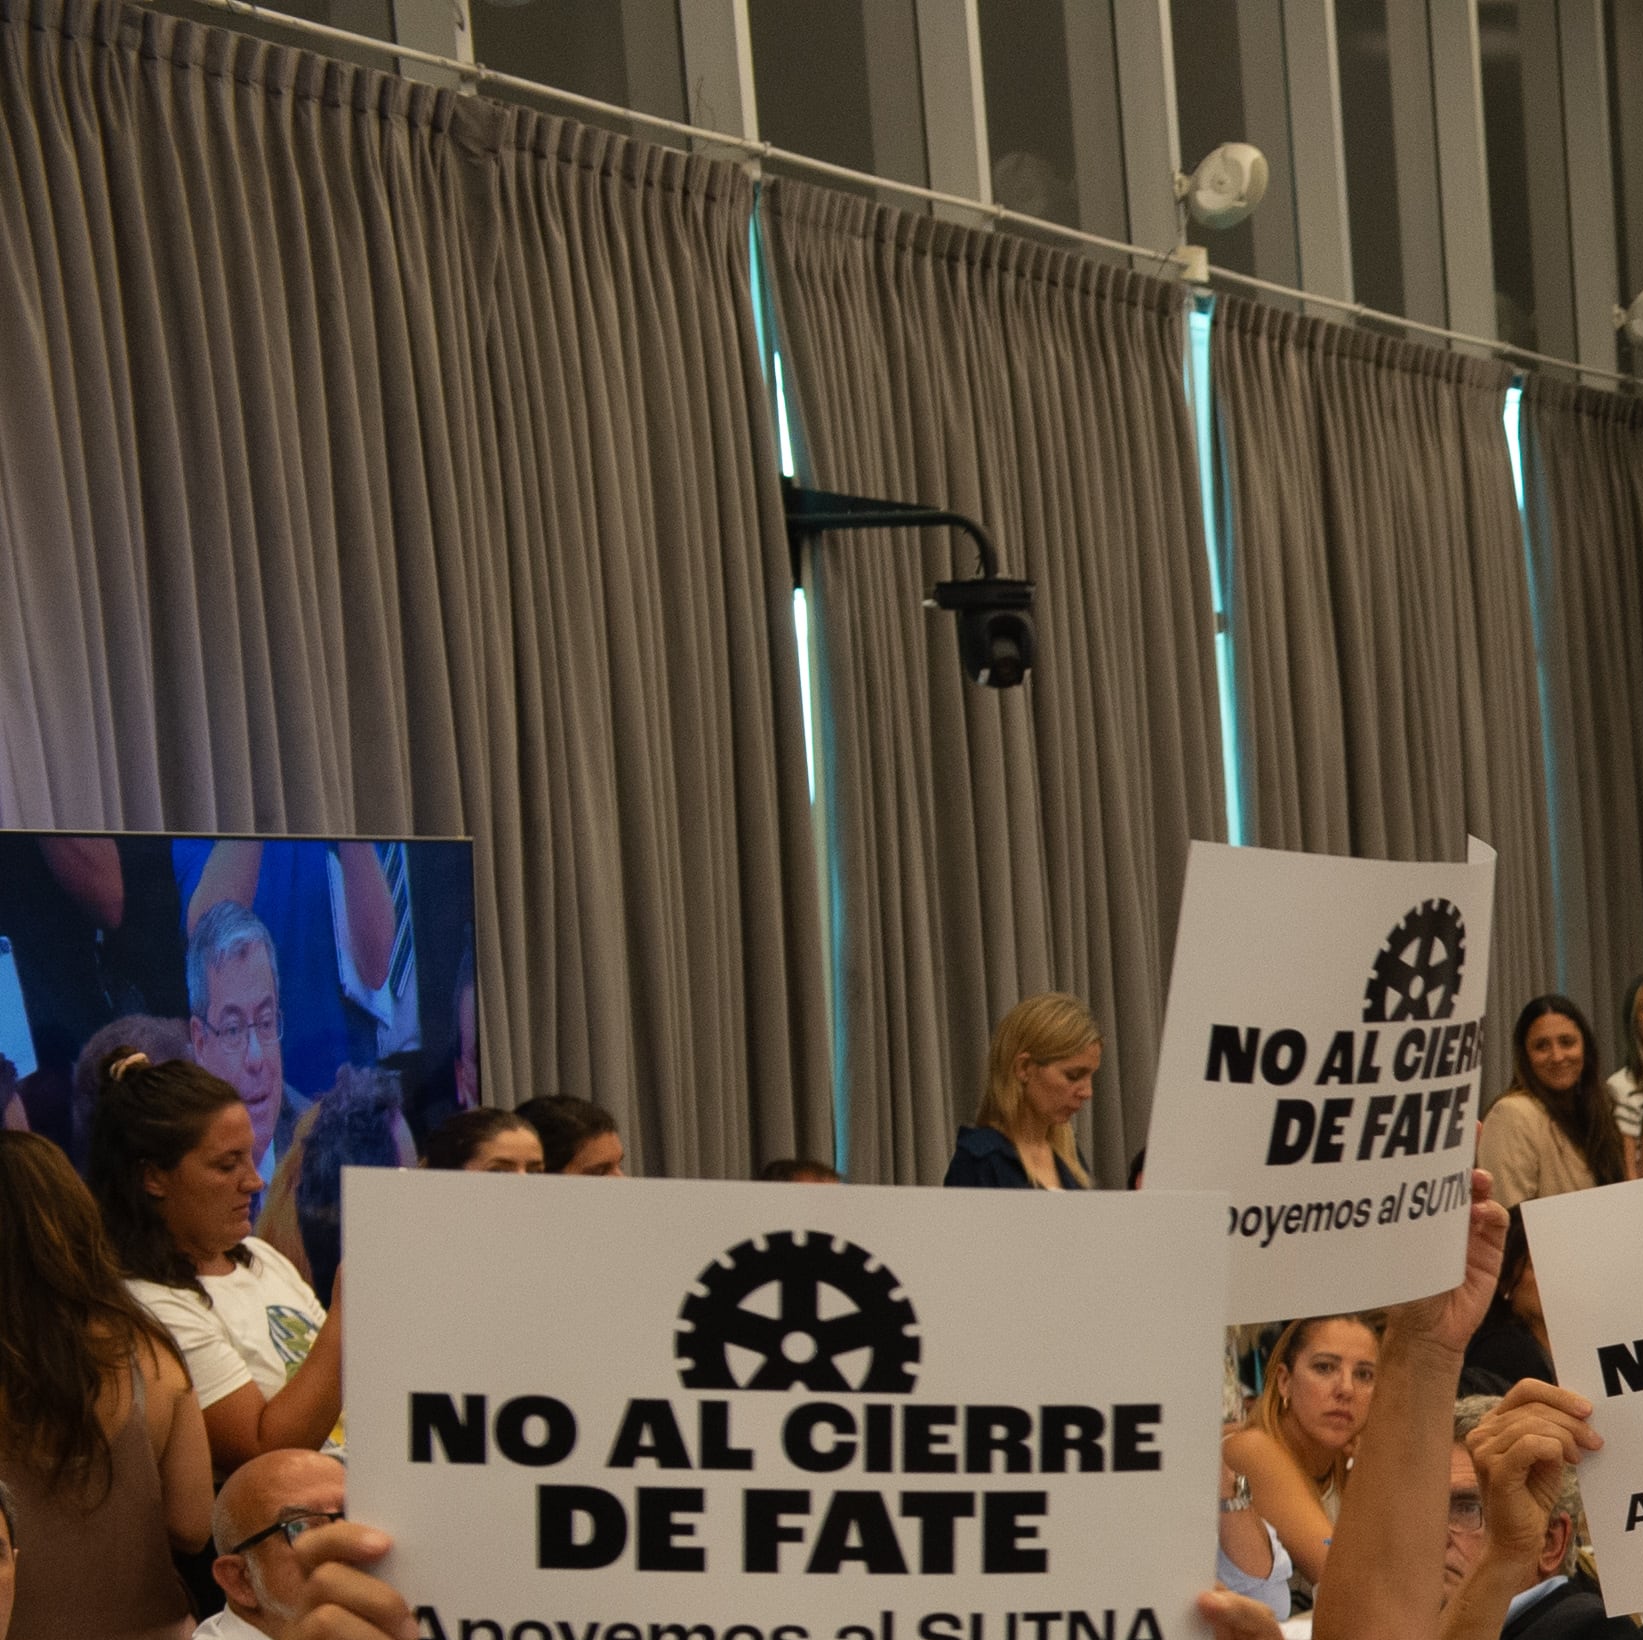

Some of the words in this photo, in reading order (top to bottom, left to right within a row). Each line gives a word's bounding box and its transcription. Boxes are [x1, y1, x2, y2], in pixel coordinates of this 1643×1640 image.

[1205, 1023, 1307, 1086] NO
[1316, 1030, 1380, 1085] AL
[1265, 1098, 1354, 1166] DE
[1357, 1084, 1471, 1160] FATE
[1378, 1183, 1407, 1225] al
[408, 1393, 578, 1467] NO
[607, 1399, 755, 1471] AL
[780, 1402, 1162, 1473] CIERRE
[536, 1484, 706, 1573] DE
[743, 1489, 1049, 1575] FATE
